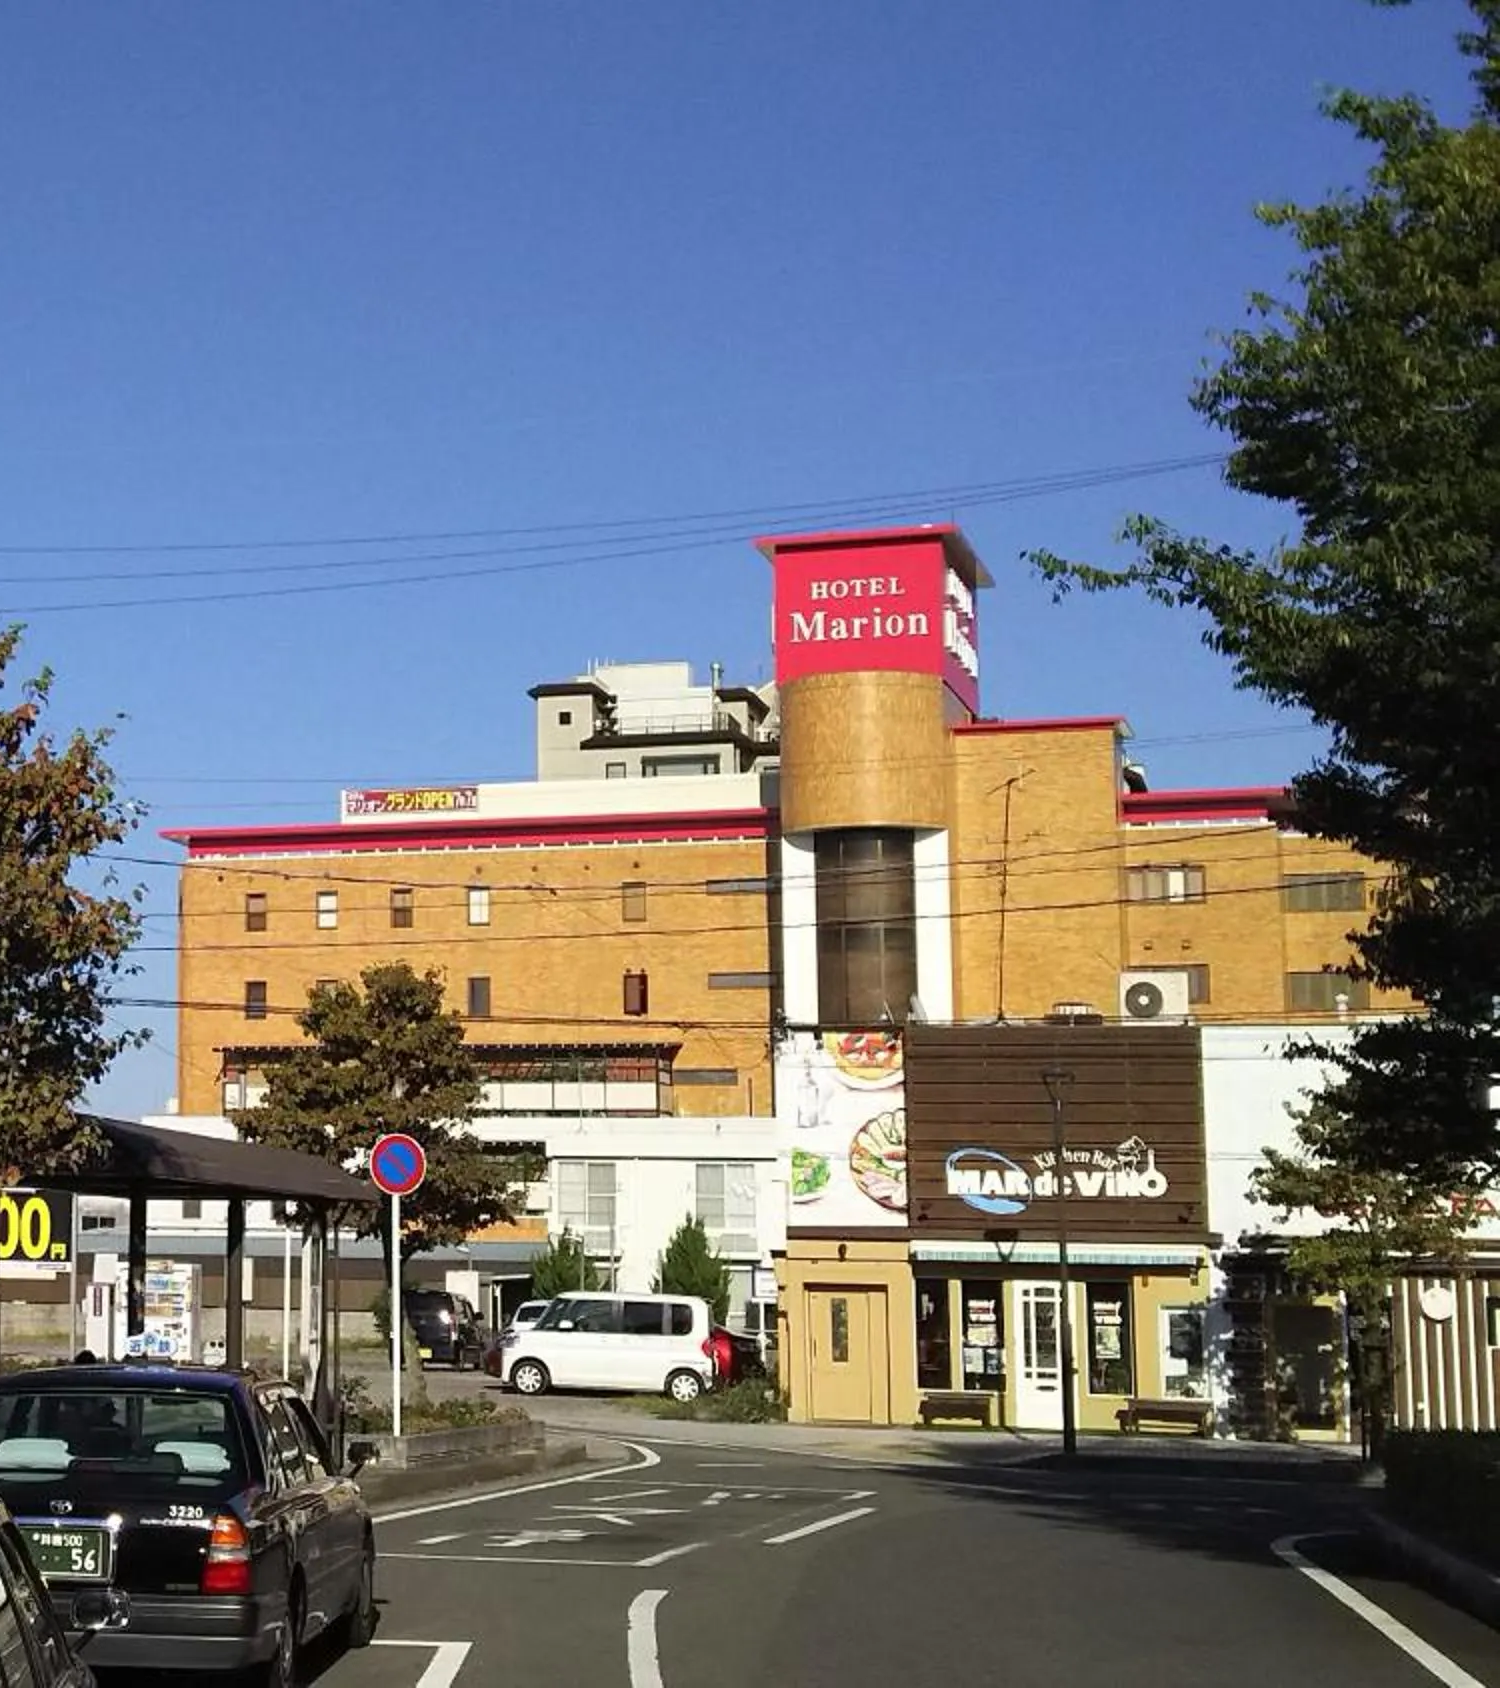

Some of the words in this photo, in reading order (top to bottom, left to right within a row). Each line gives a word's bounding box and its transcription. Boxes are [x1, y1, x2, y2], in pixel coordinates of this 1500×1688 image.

[810, 576, 906, 600] HOTEL
[789, 607, 930, 643] Marion
[1032, 1146, 1091, 1171] Kithen
[947, 1168, 1030, 1196] MAR
[168, 1504, 204, 1519] 3220
[71, 1547, 96, 1571] 56
